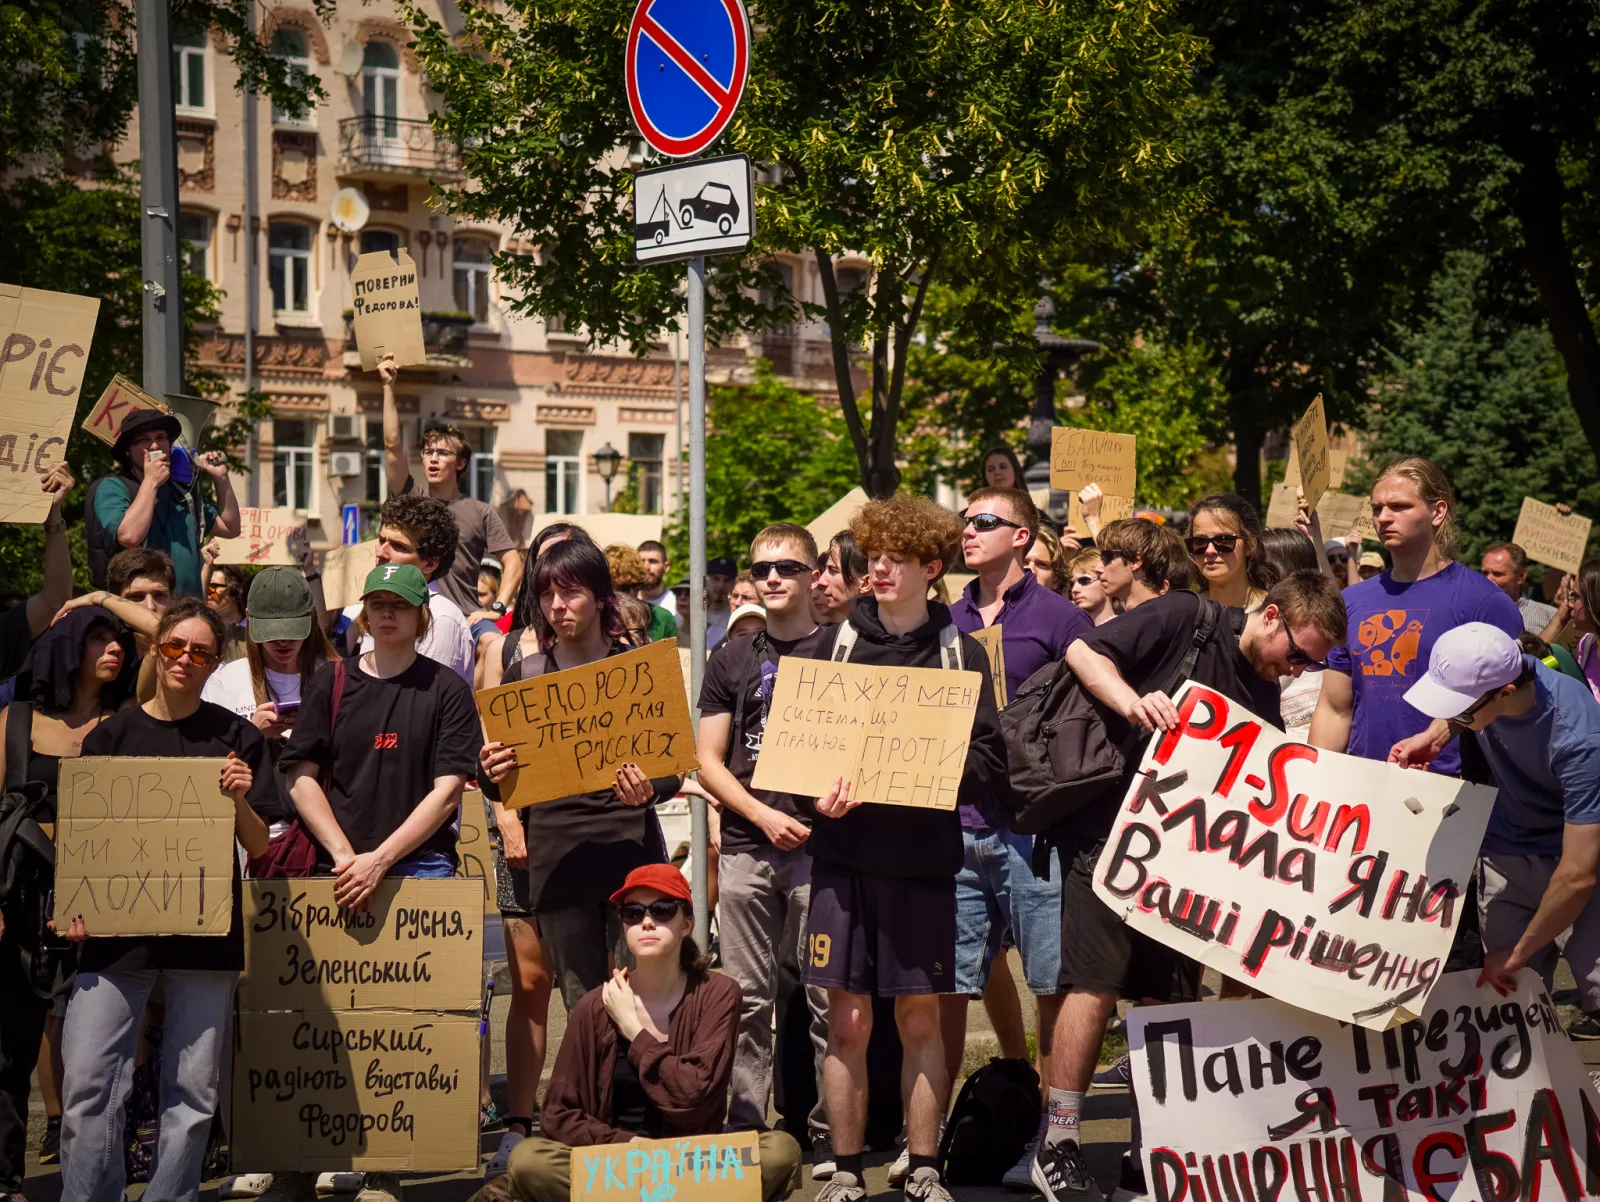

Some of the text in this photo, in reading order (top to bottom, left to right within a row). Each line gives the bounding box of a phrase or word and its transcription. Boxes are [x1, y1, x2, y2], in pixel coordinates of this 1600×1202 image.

[355, 273, 415, 296] ПОВЕРНИ
[238, 524, 308, 541] ЕДОРОВА
[489, 661, 654, 729] ФЕДОРОВ
[536, 701, 665, 749] ПЕКЛО ДЛЯ
[783, 705, 898, 732] СИСТЕМА, ЩО
[775, 731, 967, 769] ПРАЦЮЄ ПРОТИ
[69, 772, 216, 838] ВОВА,
[853, 767, 958, 808] МЕНЕ
[63, 838, 110, 865] МИ
[130, 837, 150, 864] Ж
[1128, 768, 1316, 896] Клала
[1381, 869, 1460, 931] на
[62, 866, 206, 927] ЛОХИ!
[395, 907, 473, 940] русня,
[1101, 821, 1441, 1021] Ваші рішення
[278, 944, 432, 987] Зеленський
[350, 988, 356, 1009] і
[292, 1022, 434, 1064] Сирський,
[1144, 1018, 1323, 1106] Пане
[249, 1058, 460, 1103] радіють відставці
[1357, 1074, 1487, 1128] такі
[299, 1100, 415, 1147] Федорова
[584, 1141, 744, 1193] УКРАЇНА
